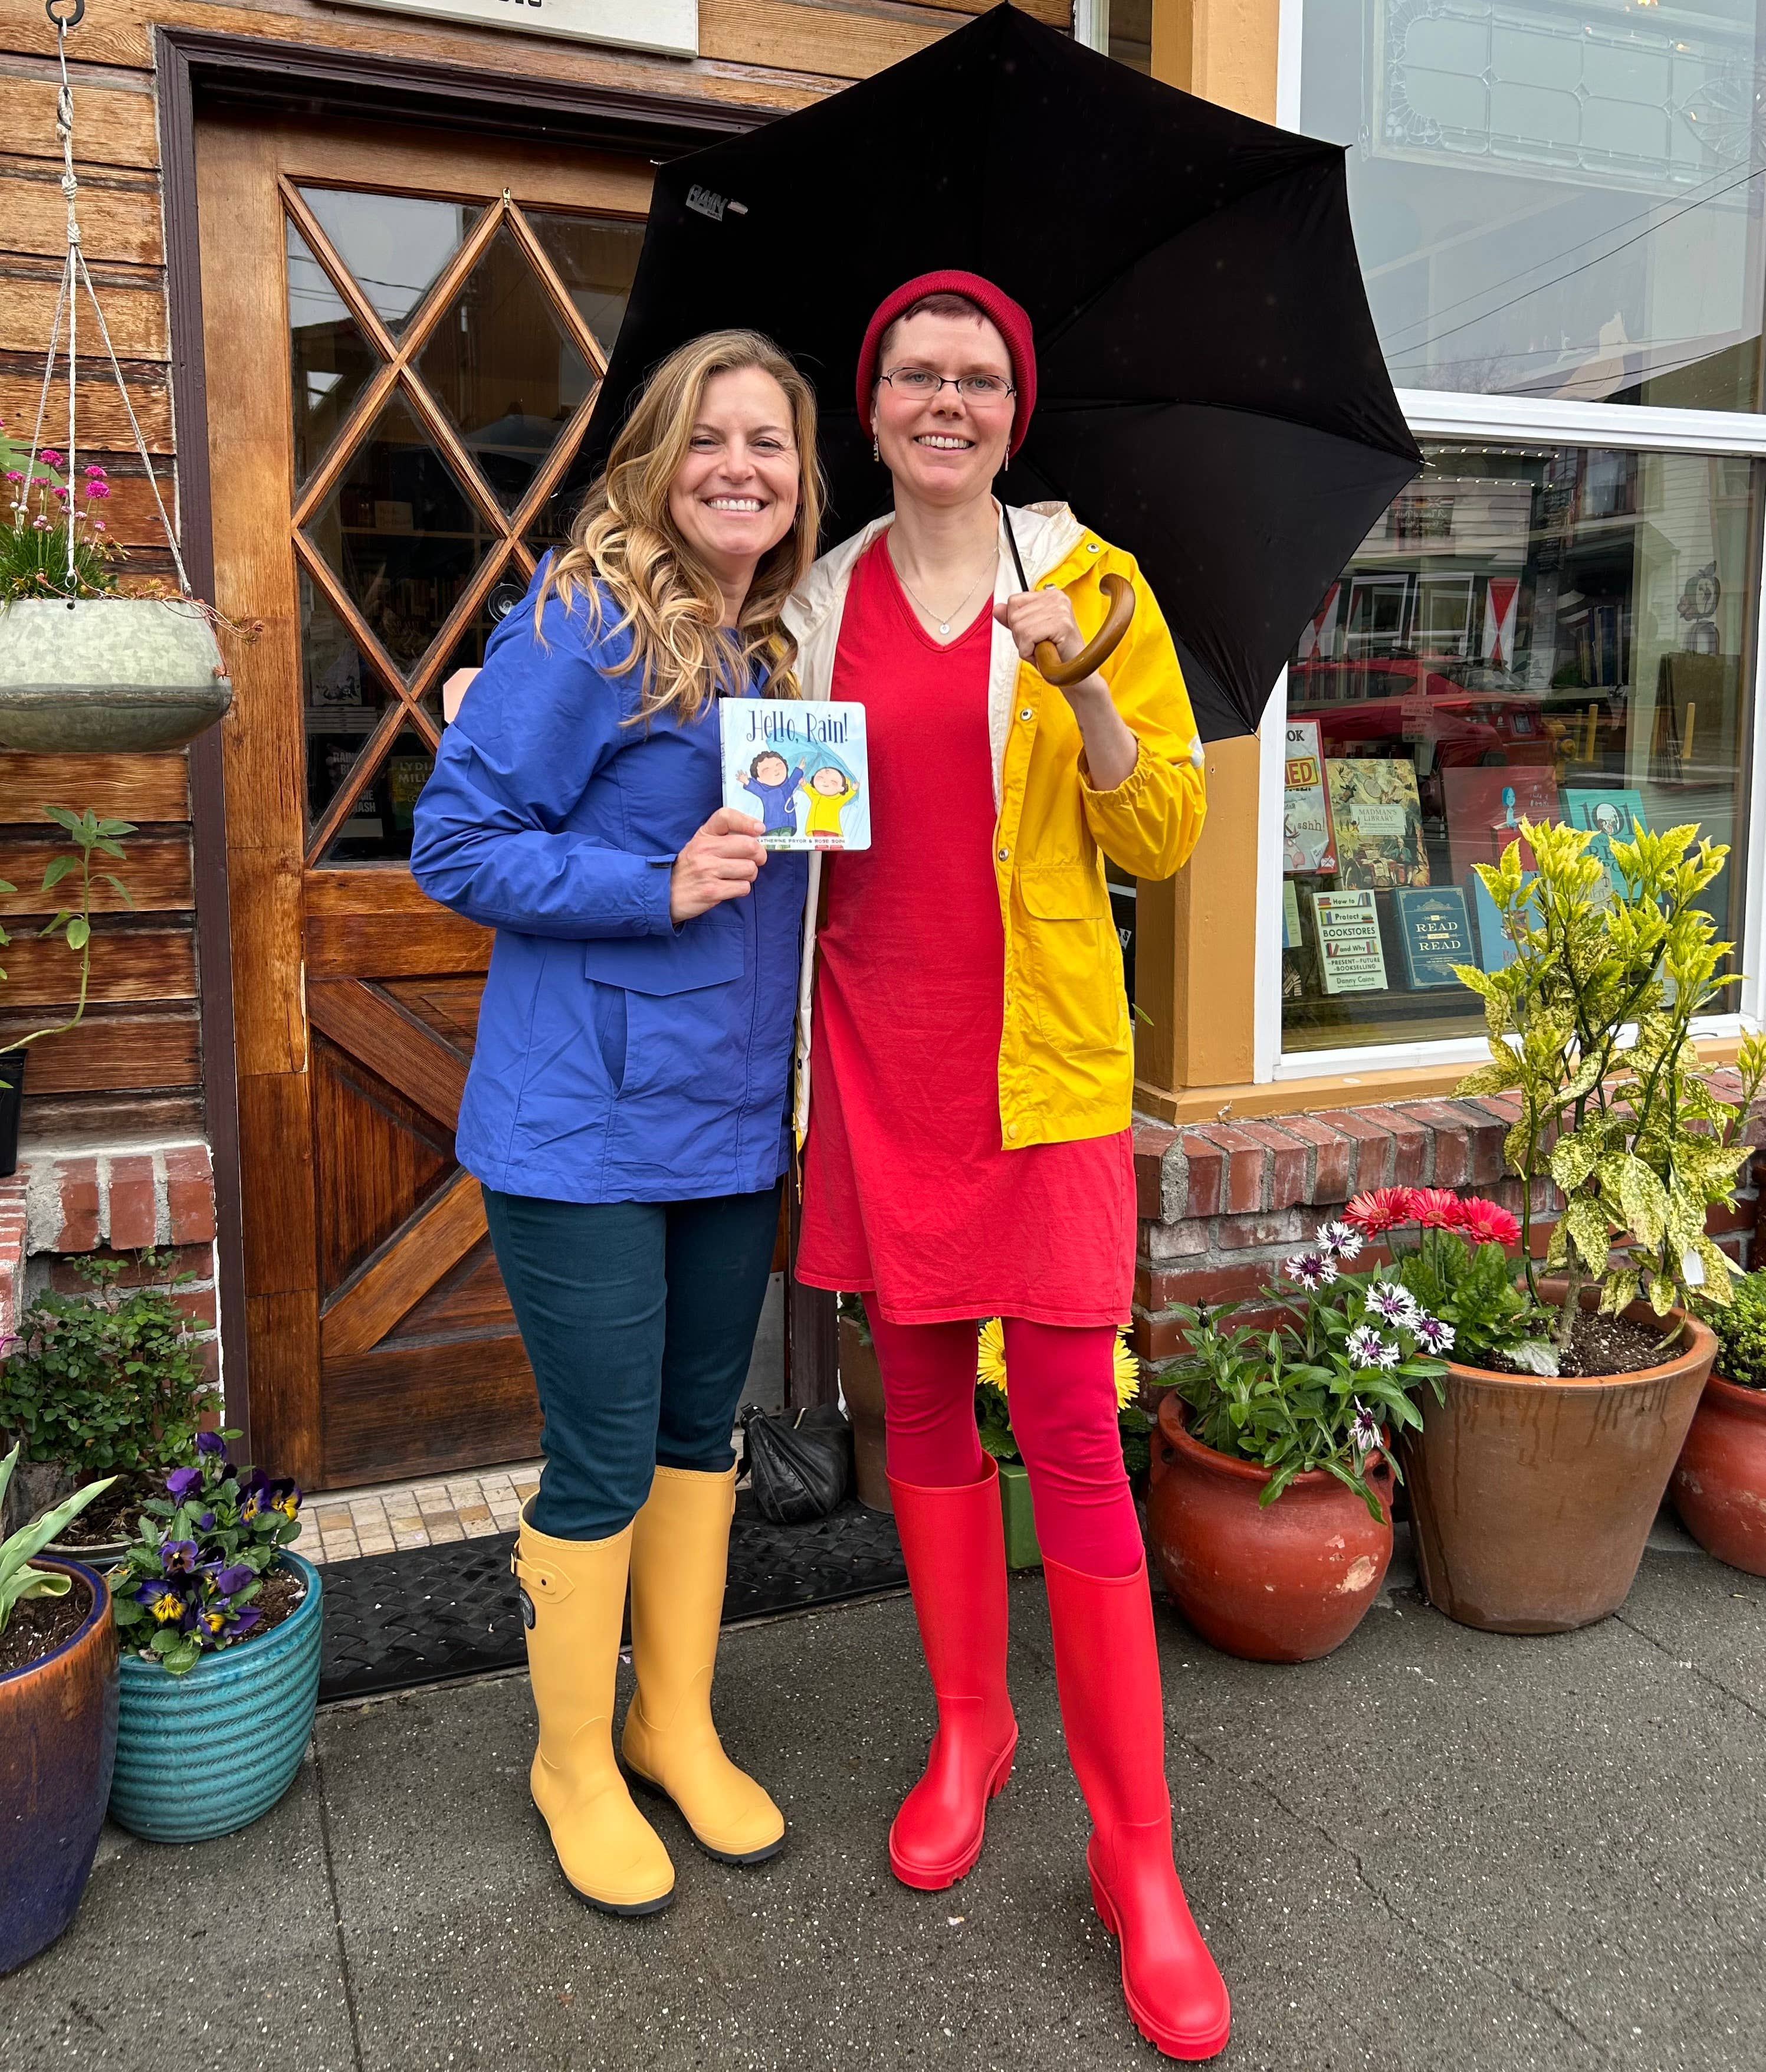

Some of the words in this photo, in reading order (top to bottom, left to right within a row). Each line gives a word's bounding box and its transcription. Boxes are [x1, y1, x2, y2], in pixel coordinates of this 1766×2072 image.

[747, 710, 799, 743] Hello,
[806, 712, 848, 744] Rain!
[400, 762, 433, 771] LYDI
[398, 774, 428, 783] MILL
[1578, 802, 1634, 835] 101
[1323, 927, 1376, 937] BOOKSTORES
[1416, 922, 1458, 932] READ
[1419, 940, 1461, 950] READ
[1336, 963, 1376, 972] BOOKSELLING
